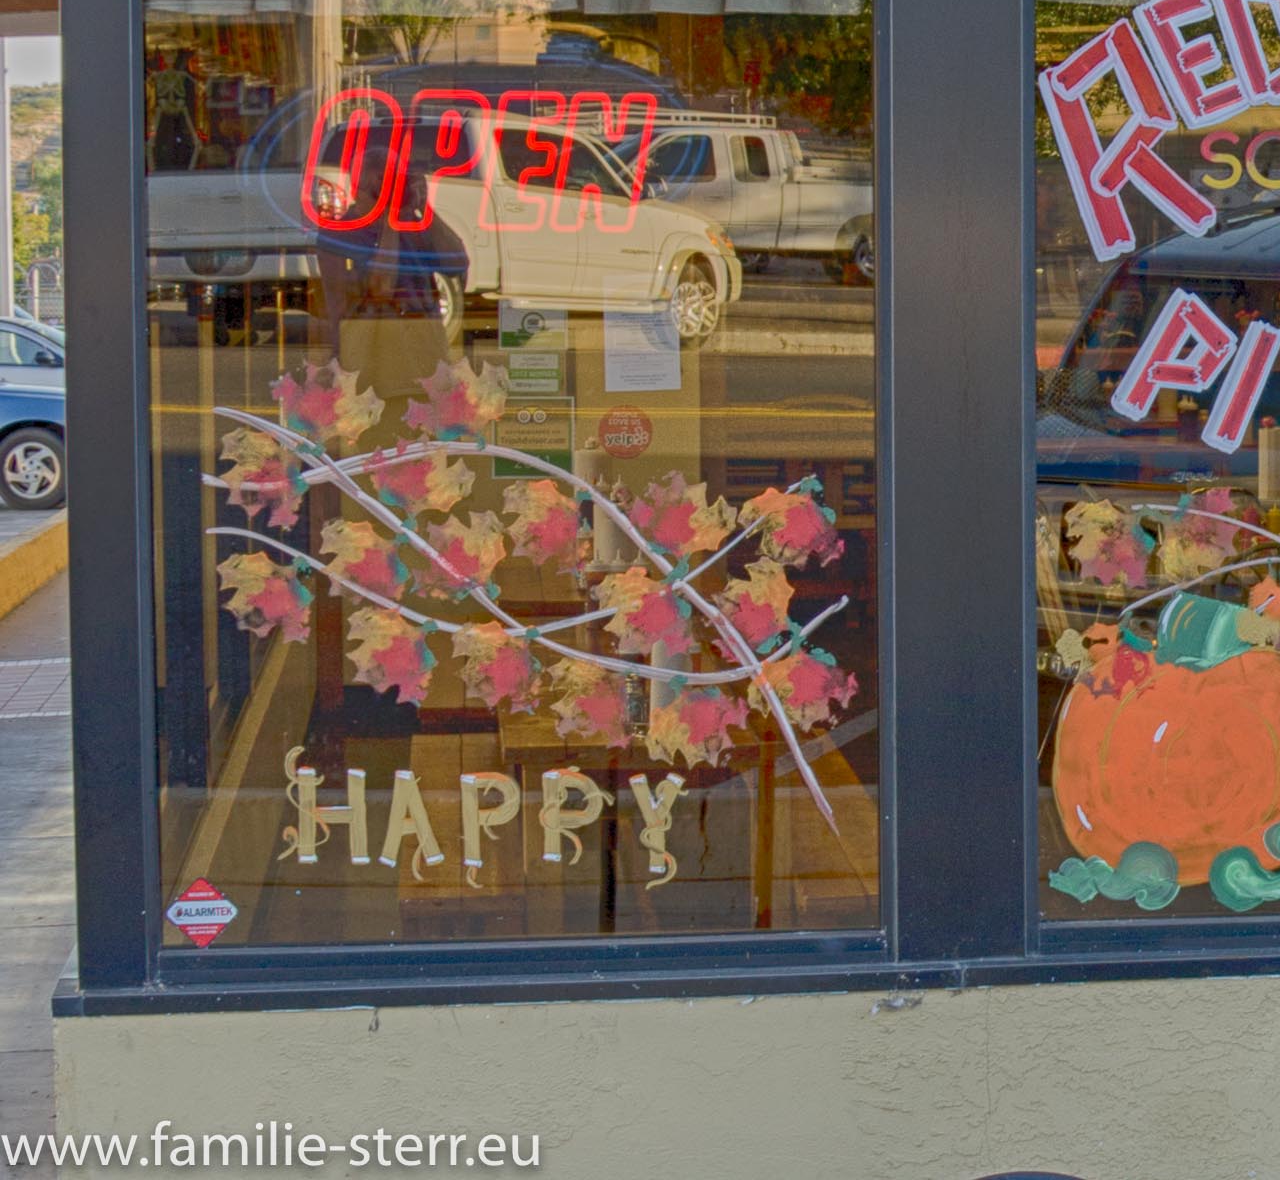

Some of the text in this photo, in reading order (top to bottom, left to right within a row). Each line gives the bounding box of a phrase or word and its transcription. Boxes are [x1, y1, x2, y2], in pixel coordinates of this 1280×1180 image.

[301, 89, 657, 233] OPEN
[605, 431, 635, 447] yelp
[282, 750, 689, 883] HAPPY
[183, 906, 233, 917] ALARMTEK
